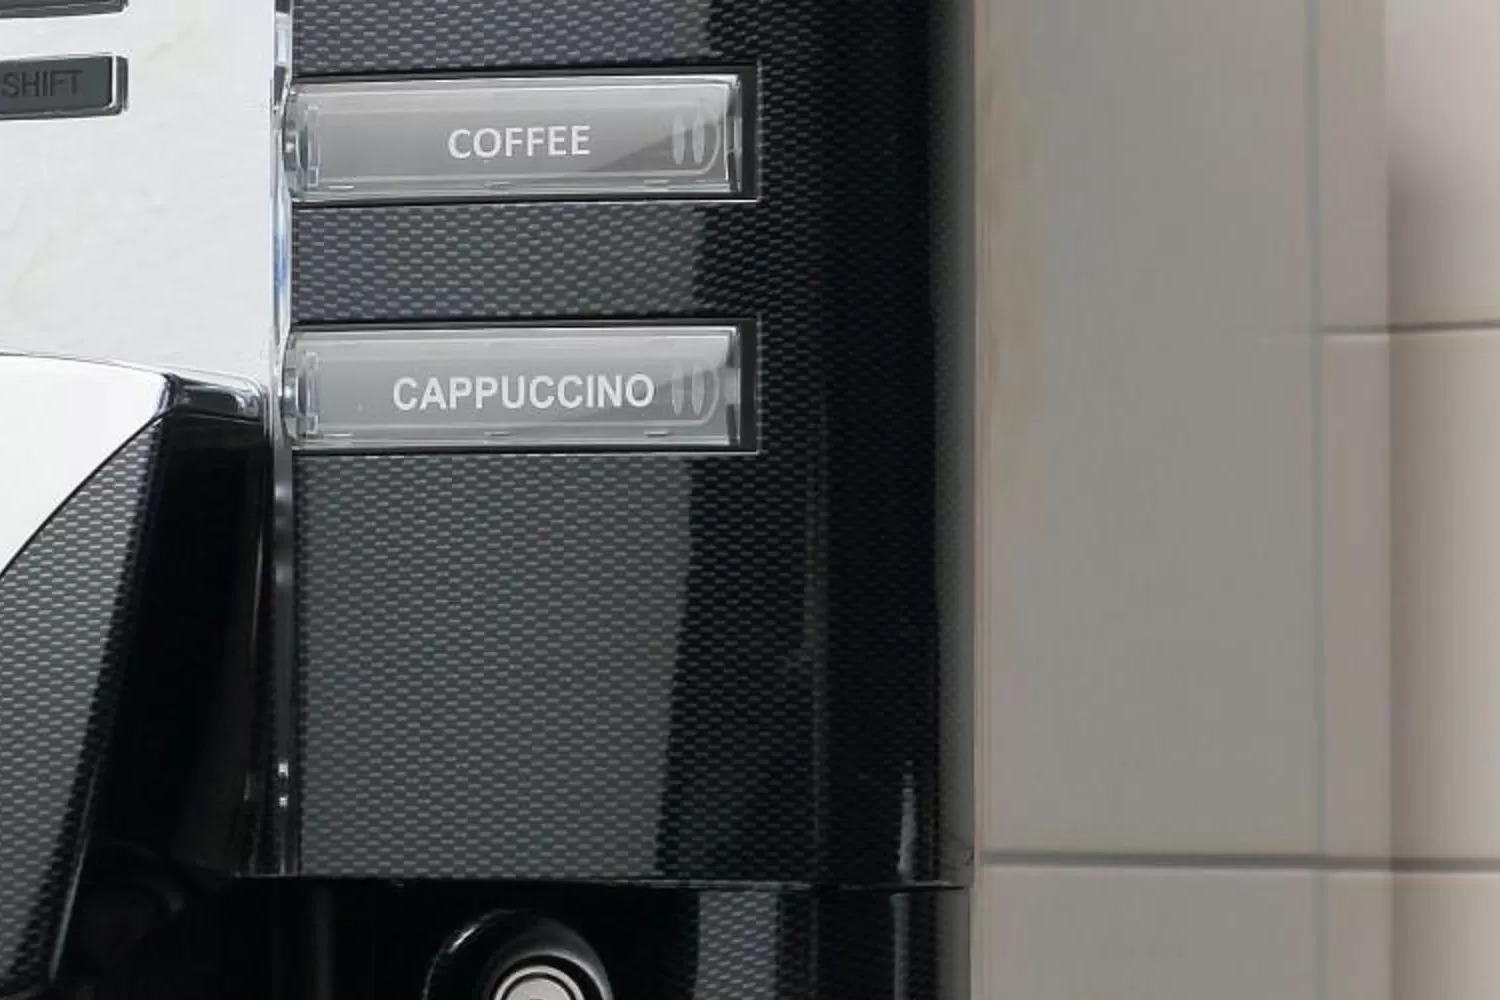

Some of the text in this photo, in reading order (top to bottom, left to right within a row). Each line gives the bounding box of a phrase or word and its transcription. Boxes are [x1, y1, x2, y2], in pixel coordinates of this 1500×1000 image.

[0, 68, 85, 99] SHIFT
[447, 124, 592, 159] COFFEE
[392, 373, 656, 411] CAPPUCCINO
